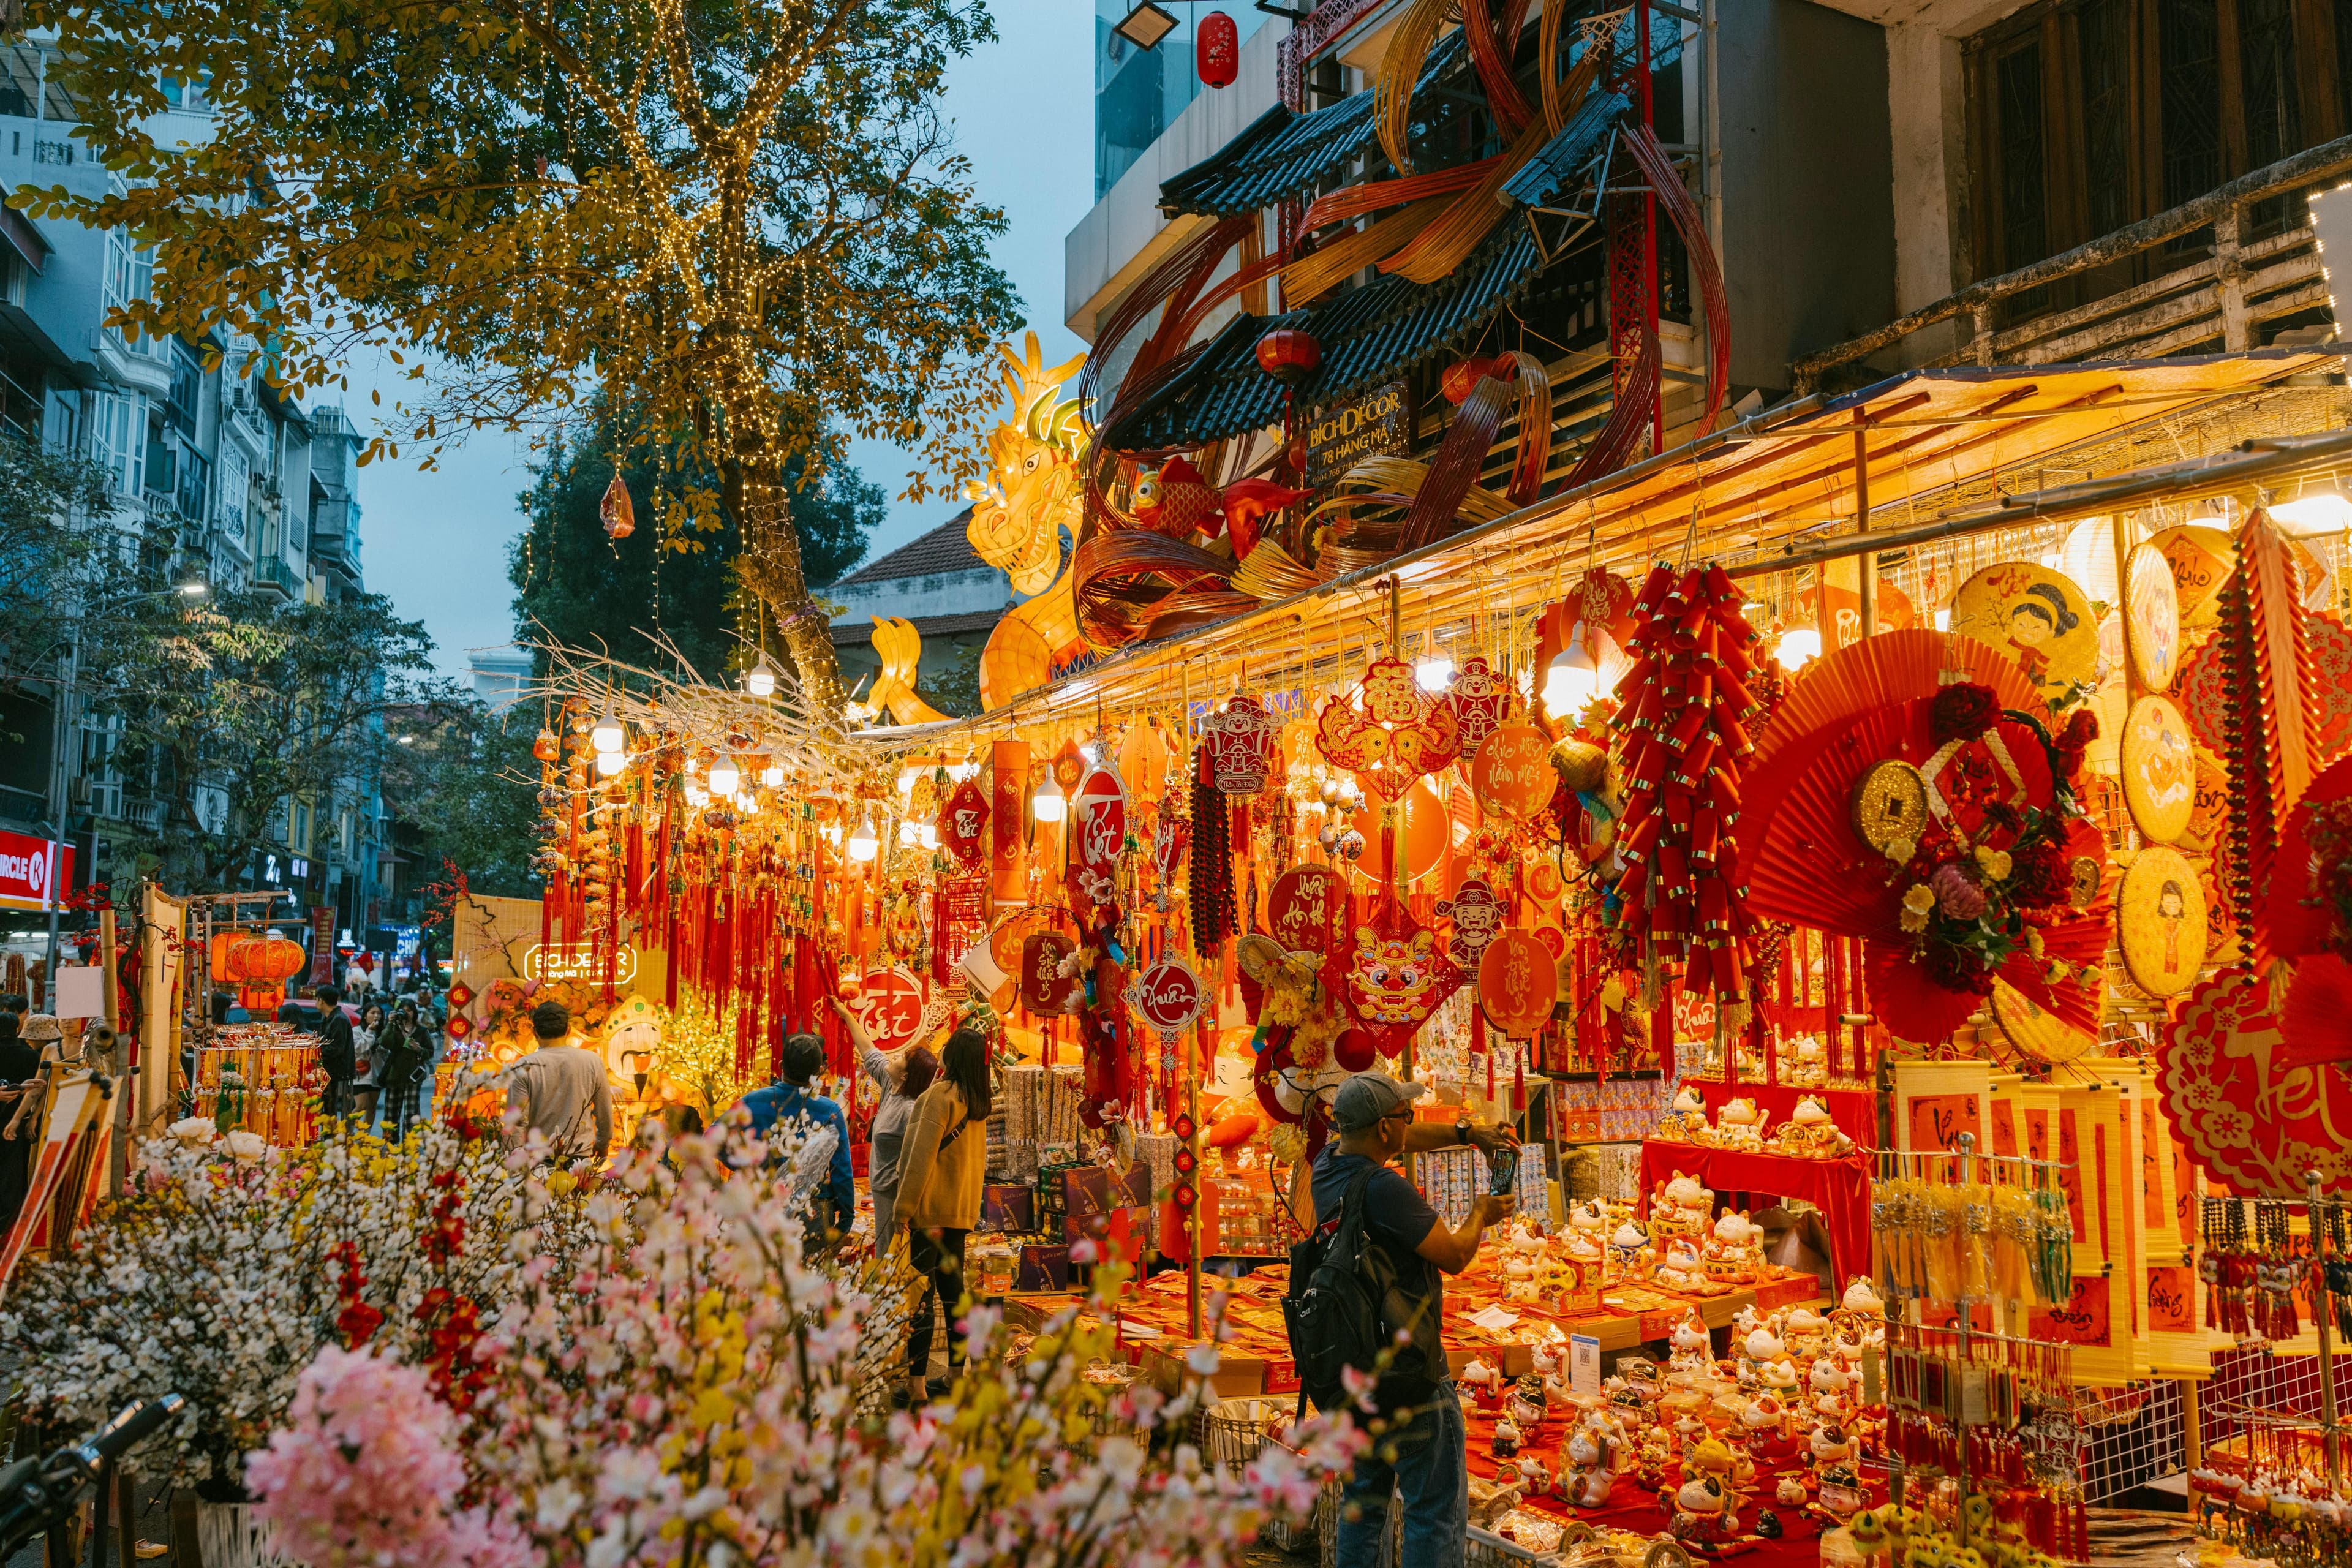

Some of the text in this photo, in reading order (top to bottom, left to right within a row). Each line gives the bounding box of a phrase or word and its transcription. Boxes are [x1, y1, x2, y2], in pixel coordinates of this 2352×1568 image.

[1313, 473, 1327, 484] 0904
[1329, 467, 1340, 477] 766
[1342, 461, 1352, 472] 716
[1389, 441, 1401, 453] 888
[1322, 450, 1334, 466] 78
[1336, 434, 1368, 460] HÀNG
[956, 809, 979, 839] Tết
[1078, 794, 1125, 865] Tết
[0, 854, 28, 880] IRCLE
[1141, 965, 1197, 1024] Xuân
